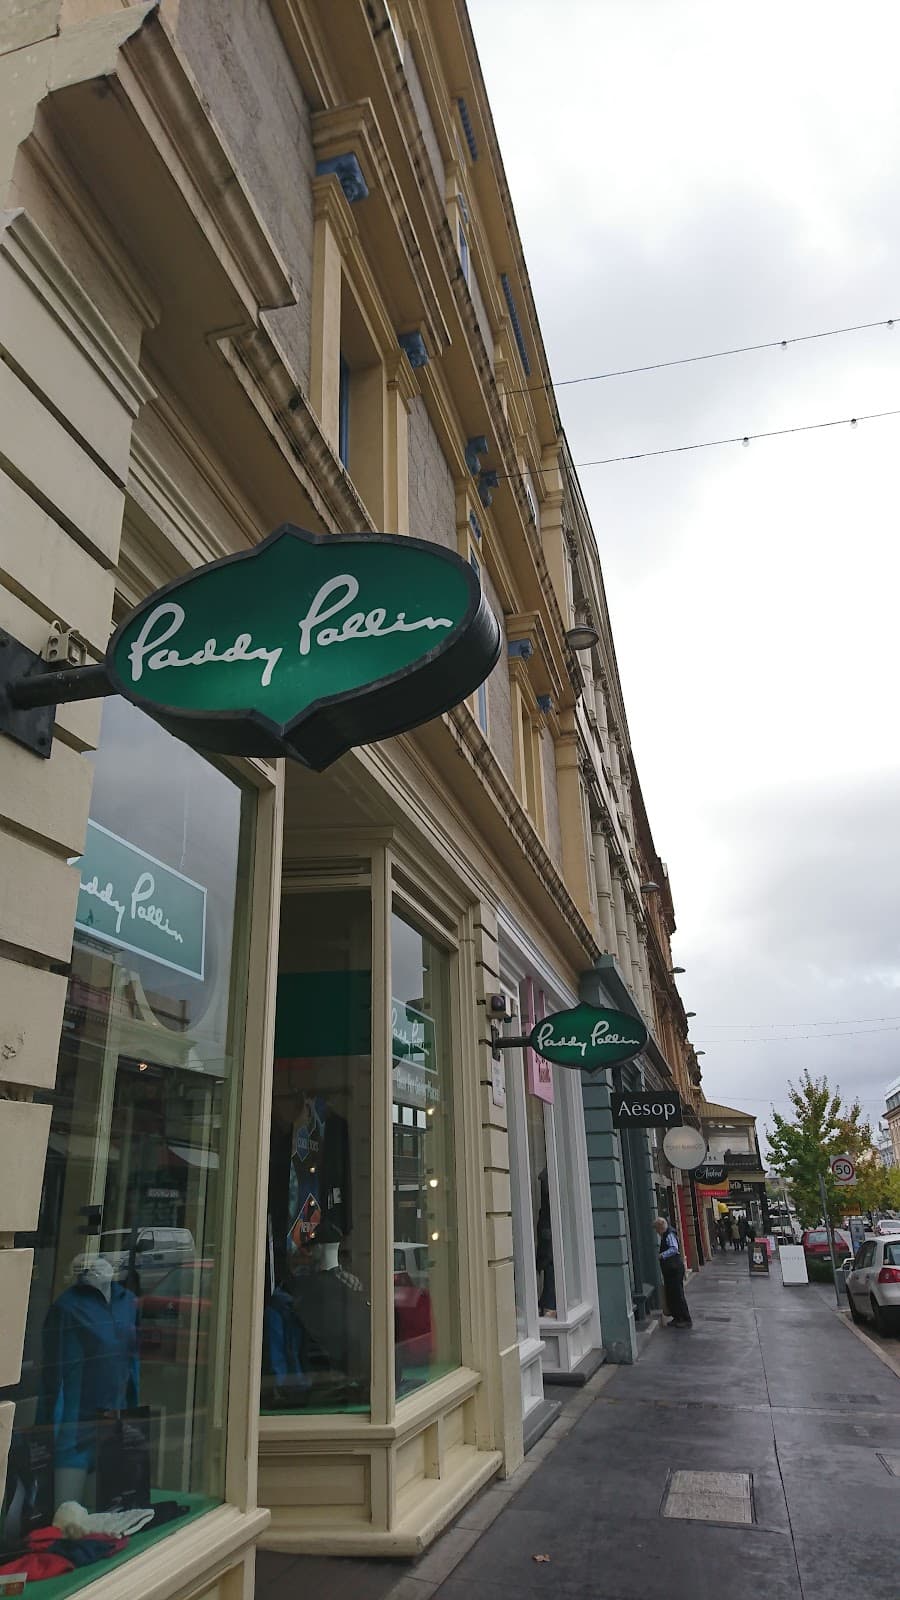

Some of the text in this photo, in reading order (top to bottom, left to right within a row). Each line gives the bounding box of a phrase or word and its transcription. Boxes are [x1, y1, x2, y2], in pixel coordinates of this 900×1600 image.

[128, 573, 454, 687] Paddy Pallin
[131, 872, 183, 944] Pallin
[536, 1020, 640, 1056] Paddy Pallin
[618, 1101, 676, 1120] Aēsop
[835, 1164, 851, 1176] 50
